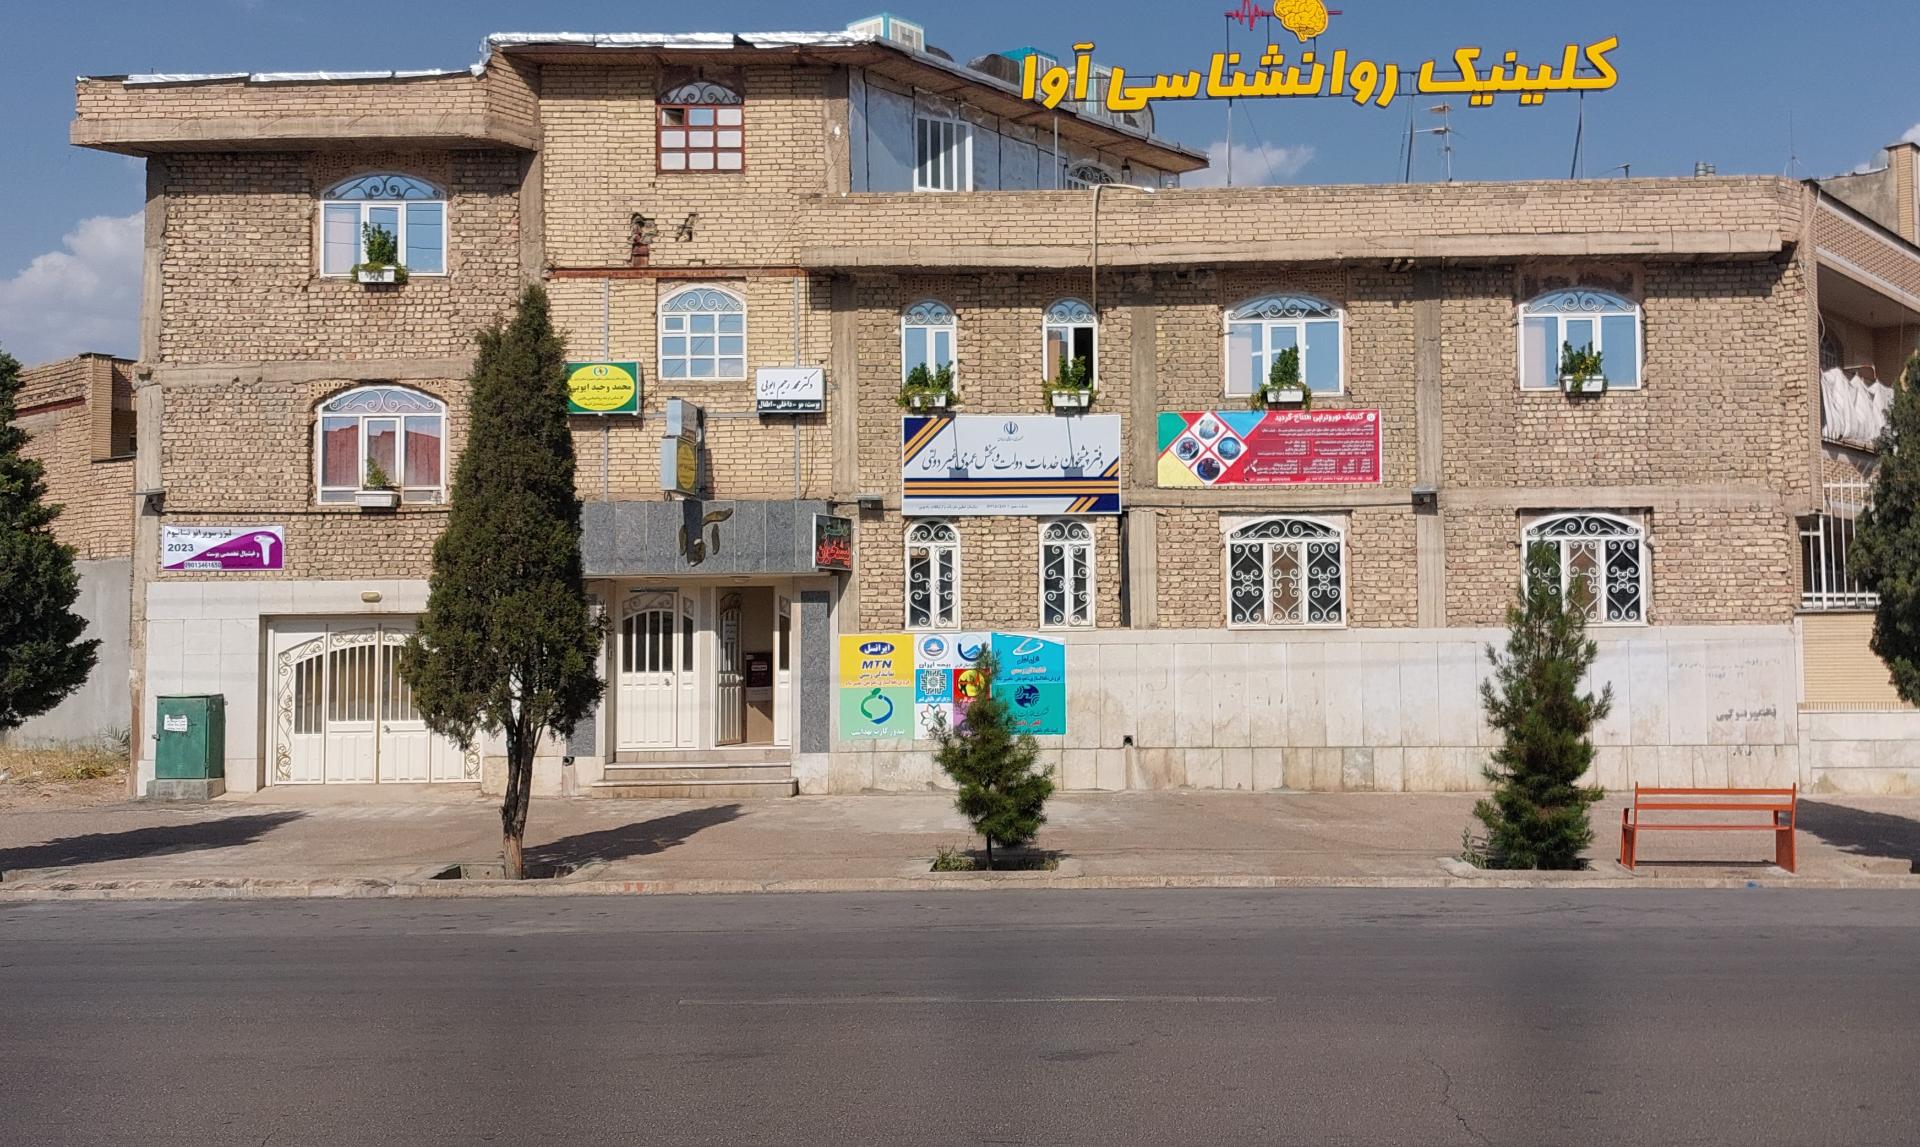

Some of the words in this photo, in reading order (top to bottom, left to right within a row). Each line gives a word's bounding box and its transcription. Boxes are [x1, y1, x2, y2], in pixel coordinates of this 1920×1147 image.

[1022, 41, 1096, 110] آوا
[1106, 43, 1400, 113] روانشناسی
[1417, 35, 1620, 107] کلینیک
[568, 383, 590, 393] ایوبی
[592, 383, 610, 393] وحید
[612, 383, 632, 391] محمد
[761, 380, 776, 396] ایوبی
[776, 380, 790, 398] رحیم
[798, 370, 819, 392] دکتر
[1342, 412, 1364, 421] کلینیک
[922, 449, 941, 471] دولتی
[938, 449, 958, 473] غیر
[957, 452, 977, 471] عمومی
[975, 444, 998, 470] بخش
[994, 452, 1023, 470] دولت
[1025, 455, 1059, 470] خدمات
[1060, 444, 1090, 470] پیشخوان
[1086, 446, 1104, 470] دفتر
[167, 543, 194, 552] 2023
[864, 643, 891, 654] ایرانسل
[862, 660, 892, 669] MTN
[850, 728, 872, 736] بهداشت
[873, 727, 888, 736] کارت
